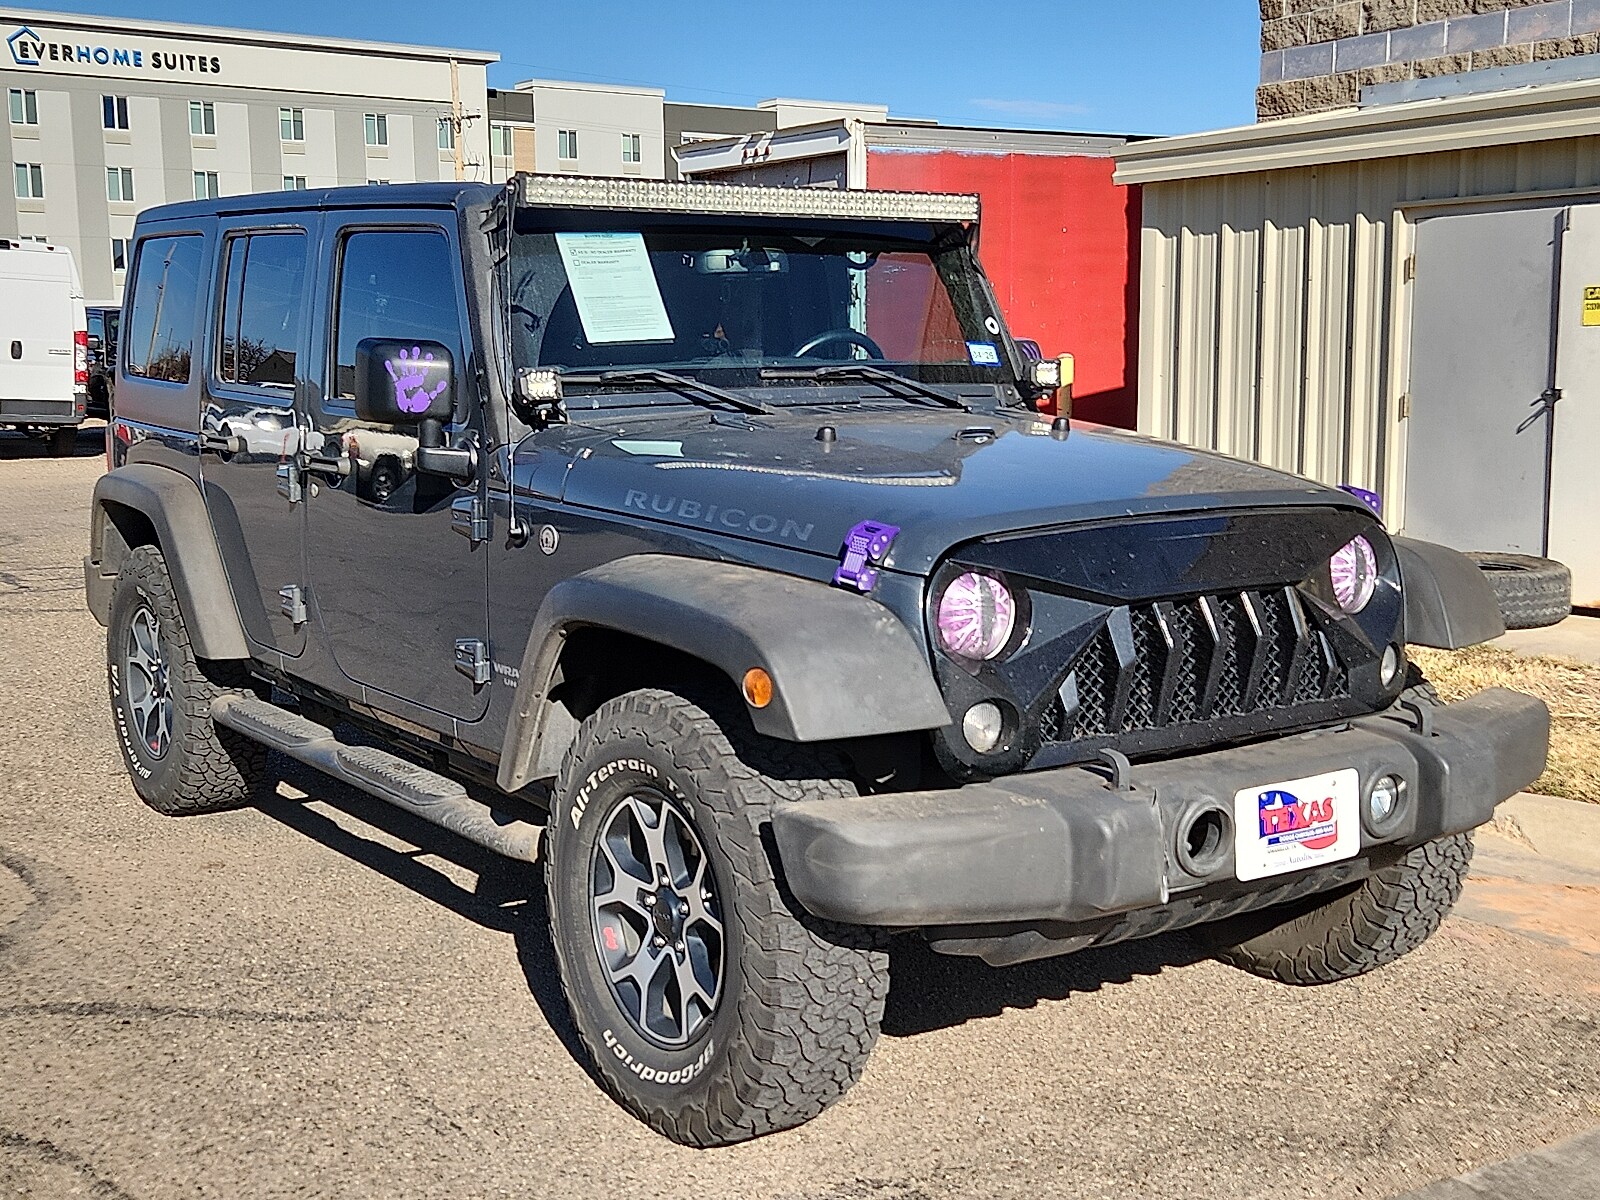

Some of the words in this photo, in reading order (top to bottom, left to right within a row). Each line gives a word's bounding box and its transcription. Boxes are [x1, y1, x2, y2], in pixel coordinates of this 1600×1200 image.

[19, 41, 143, 68] EVERHOME
[151, 52, 220, 73] SUITES
[624, 488, 815, 541] RUBICON
[492, 660, 521, 679] WRA
[503, 677, 517, 688] UN
[117, 707, 152, 780] All-Terrain
[570, 758, 658, 831] All-Terrain
[1260, 797, 1334, 835] TEXAS
[602, 1029, 714, 1084] BFGoodrich
